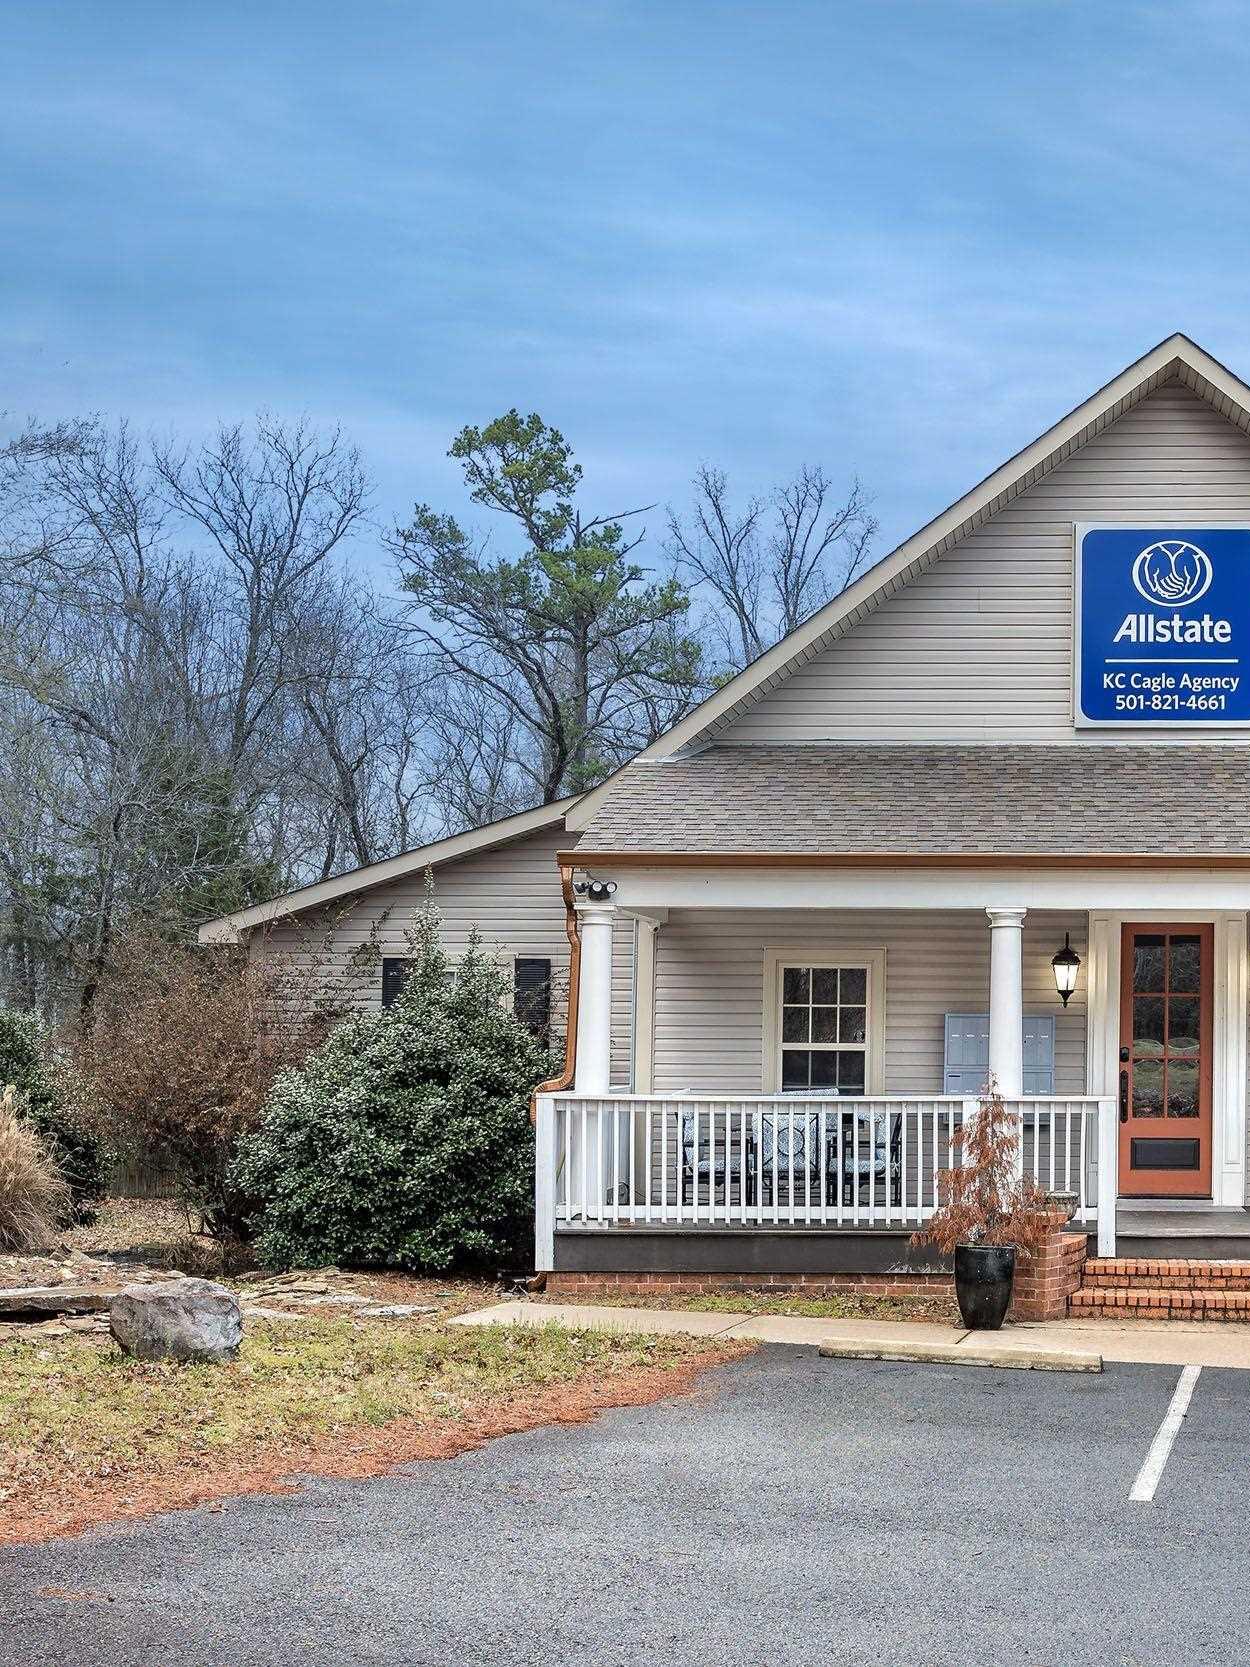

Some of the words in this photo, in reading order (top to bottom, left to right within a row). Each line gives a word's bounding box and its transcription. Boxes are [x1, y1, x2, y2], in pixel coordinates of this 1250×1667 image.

[1113, 614, 1232, 643] Allstate
[1103, 674, 1126, 689] KC
[1130, 673, 1176, 691] Cagle
[1179, 673, 1240, 692] Agency
[1115, 695, 1226, 710] 501-821-4661
